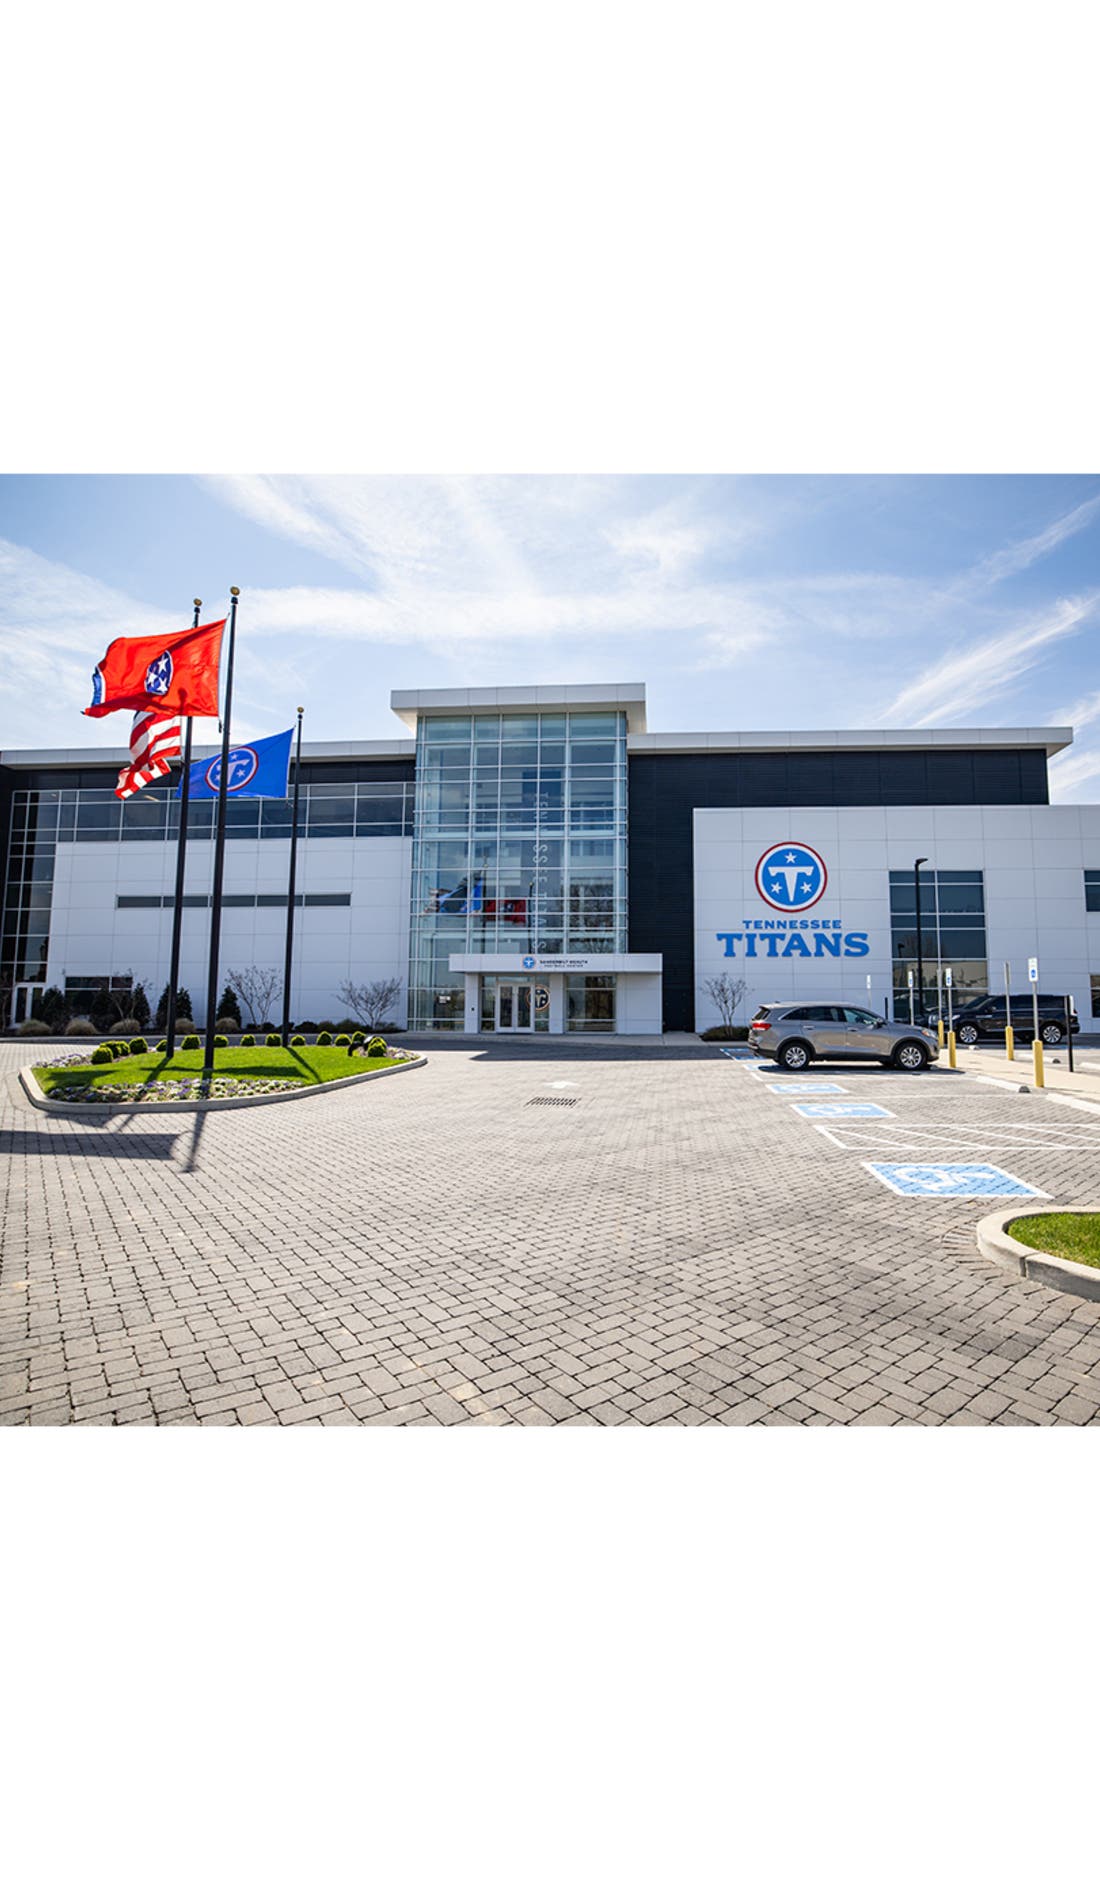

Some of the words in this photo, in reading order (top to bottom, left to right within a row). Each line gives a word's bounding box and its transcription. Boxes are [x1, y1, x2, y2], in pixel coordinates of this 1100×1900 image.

[767, 866, 814, 902] T
[742, 919, 842, 930] TENNESSEE
[716, 932, 870, 957] TITANS
